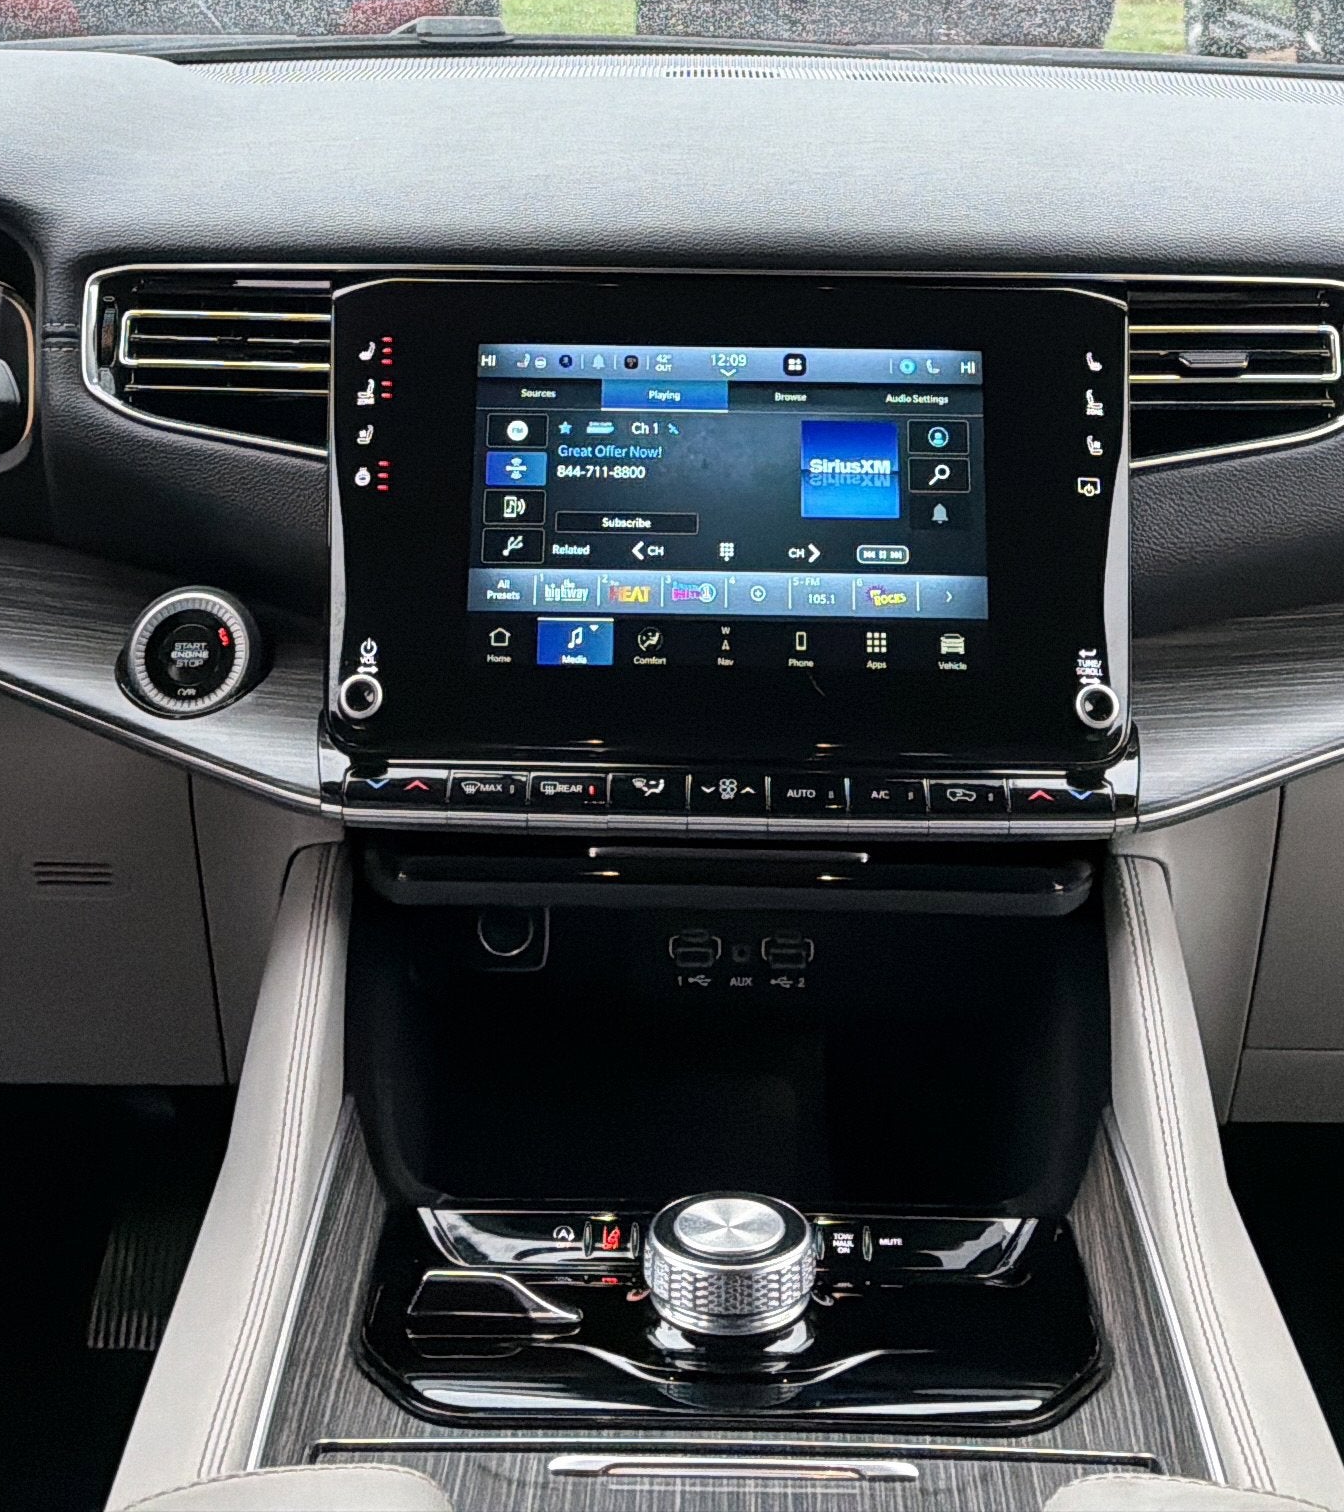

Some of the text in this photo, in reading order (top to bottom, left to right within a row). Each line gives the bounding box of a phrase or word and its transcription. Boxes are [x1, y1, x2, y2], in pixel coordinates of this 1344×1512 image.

[480, 354, 497, 368] HI
[710, 353, 748, 368] 12:09
[655, 364, 673, 373] OUT
[960, 361, 976, 375] HI
[520, 388, 557, 399] Sources
[648, 390, 681, 402] Playing
[774, 393, 808, 402] Browse
[885, 393, 949, 406] Audio Settings
[631, 422, 650, 435] Ch
[652, 422, 659, 435] 1
[558, 445, 663, 459] Great Offer Now!
[556, 465, 646, 479] 844-711-8800
[809, 459, 892, 475] SiriusXM
[601, 517, 652, 529] Subscribe
[552, 544, 590, 556] Related
[647, 545, 665, 557] CH
[788, 547, 805, 559] CH
[601, 574, 609, 583] 2
[664, 574, 672, 584] 3
[728, 577, 736, 586] 4
[497, 579, 511, 590] All
[486, 590, 521, 600] Presets
[544, 583, 589, 602] highway
[609, 586, 651, 603] HEAT
[808, 593, 836, 605] 105.1
[174, 642, 208, 651] START
[170, 650, 209, 659] ENGINE
[486, 654, 512, 664] Home
[175, 659, 204, 668] STOP
[561, 655, 588, 665] Media
[633, 656, 667, 666] Comfort
[717, 657, 735, 667] Nav
[788, 658, 815, 668] Phone
[866, 660, 888, 671] Apps
[937, 661, 968, 671] Vehicle
[479, 783, 503, 793] MAX
[558, 784, 583, 794] REAR
[786, 789, 816, 799] AUTO
[871, 790, 890, 800] A/C
[729, 976, 754, 988] AUX
[878, 1238, 903, 1246] MUTE
